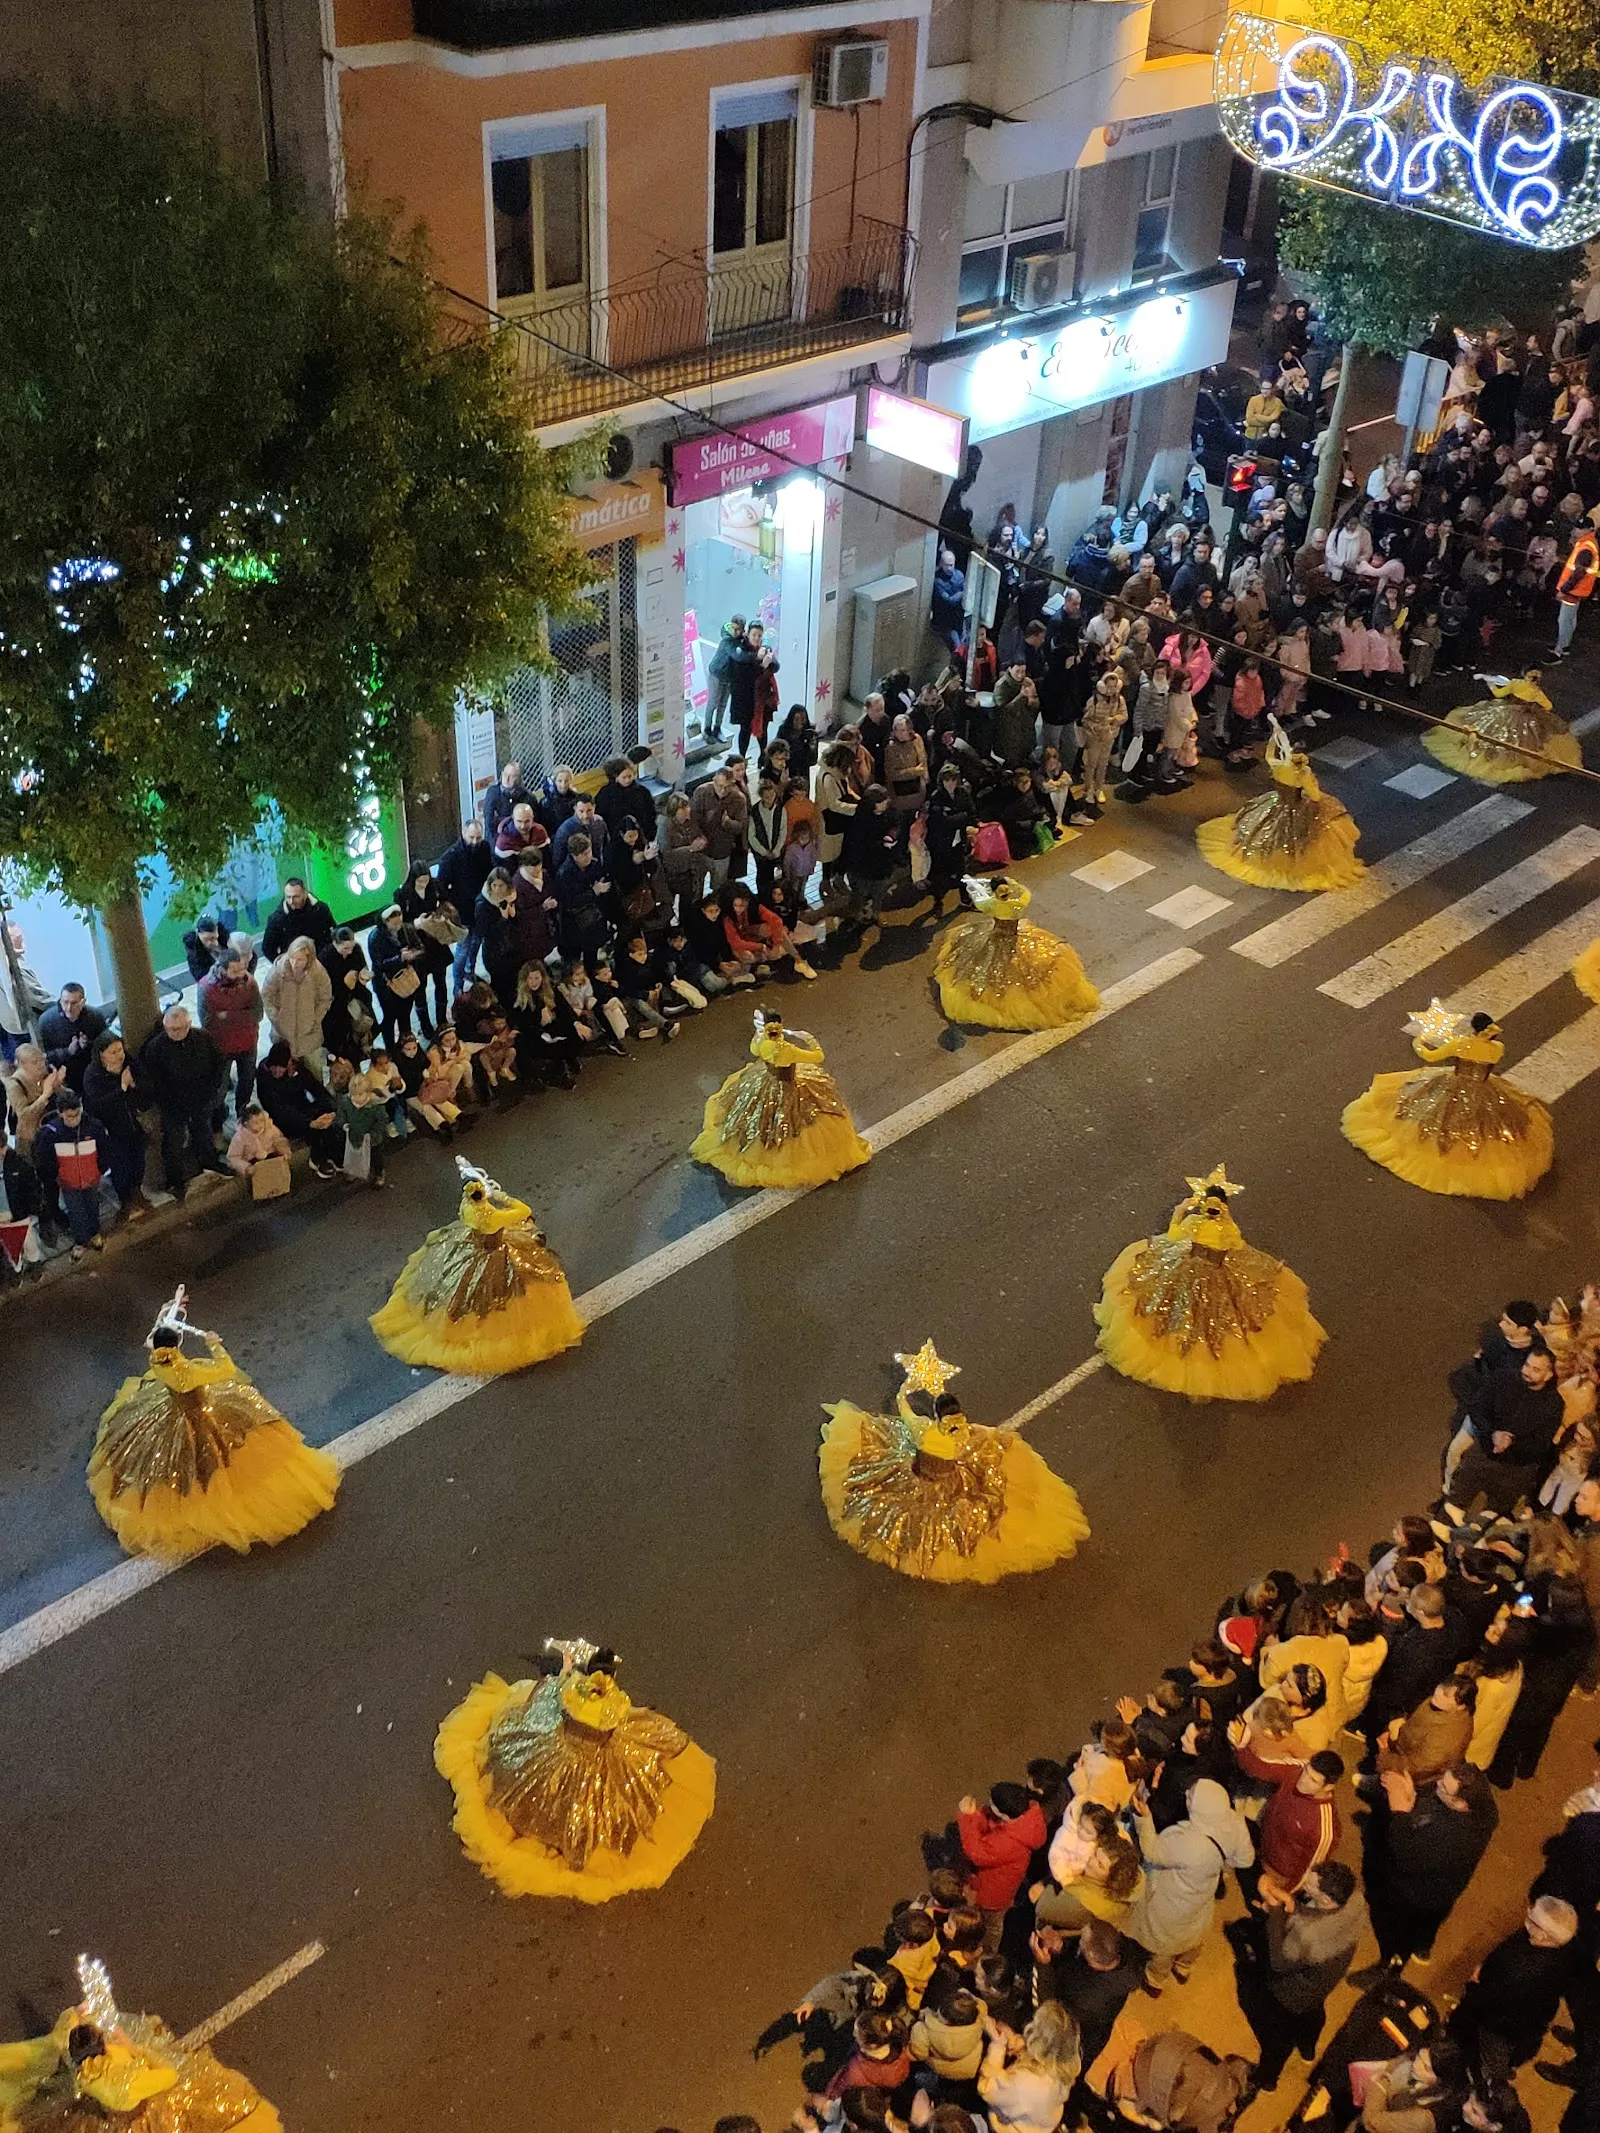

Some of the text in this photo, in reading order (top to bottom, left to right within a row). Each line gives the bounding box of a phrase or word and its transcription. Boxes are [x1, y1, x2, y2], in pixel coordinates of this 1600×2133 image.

[700, 428, 791, 471] Salón de uñas
[720, 462, 771, 488] Milena
